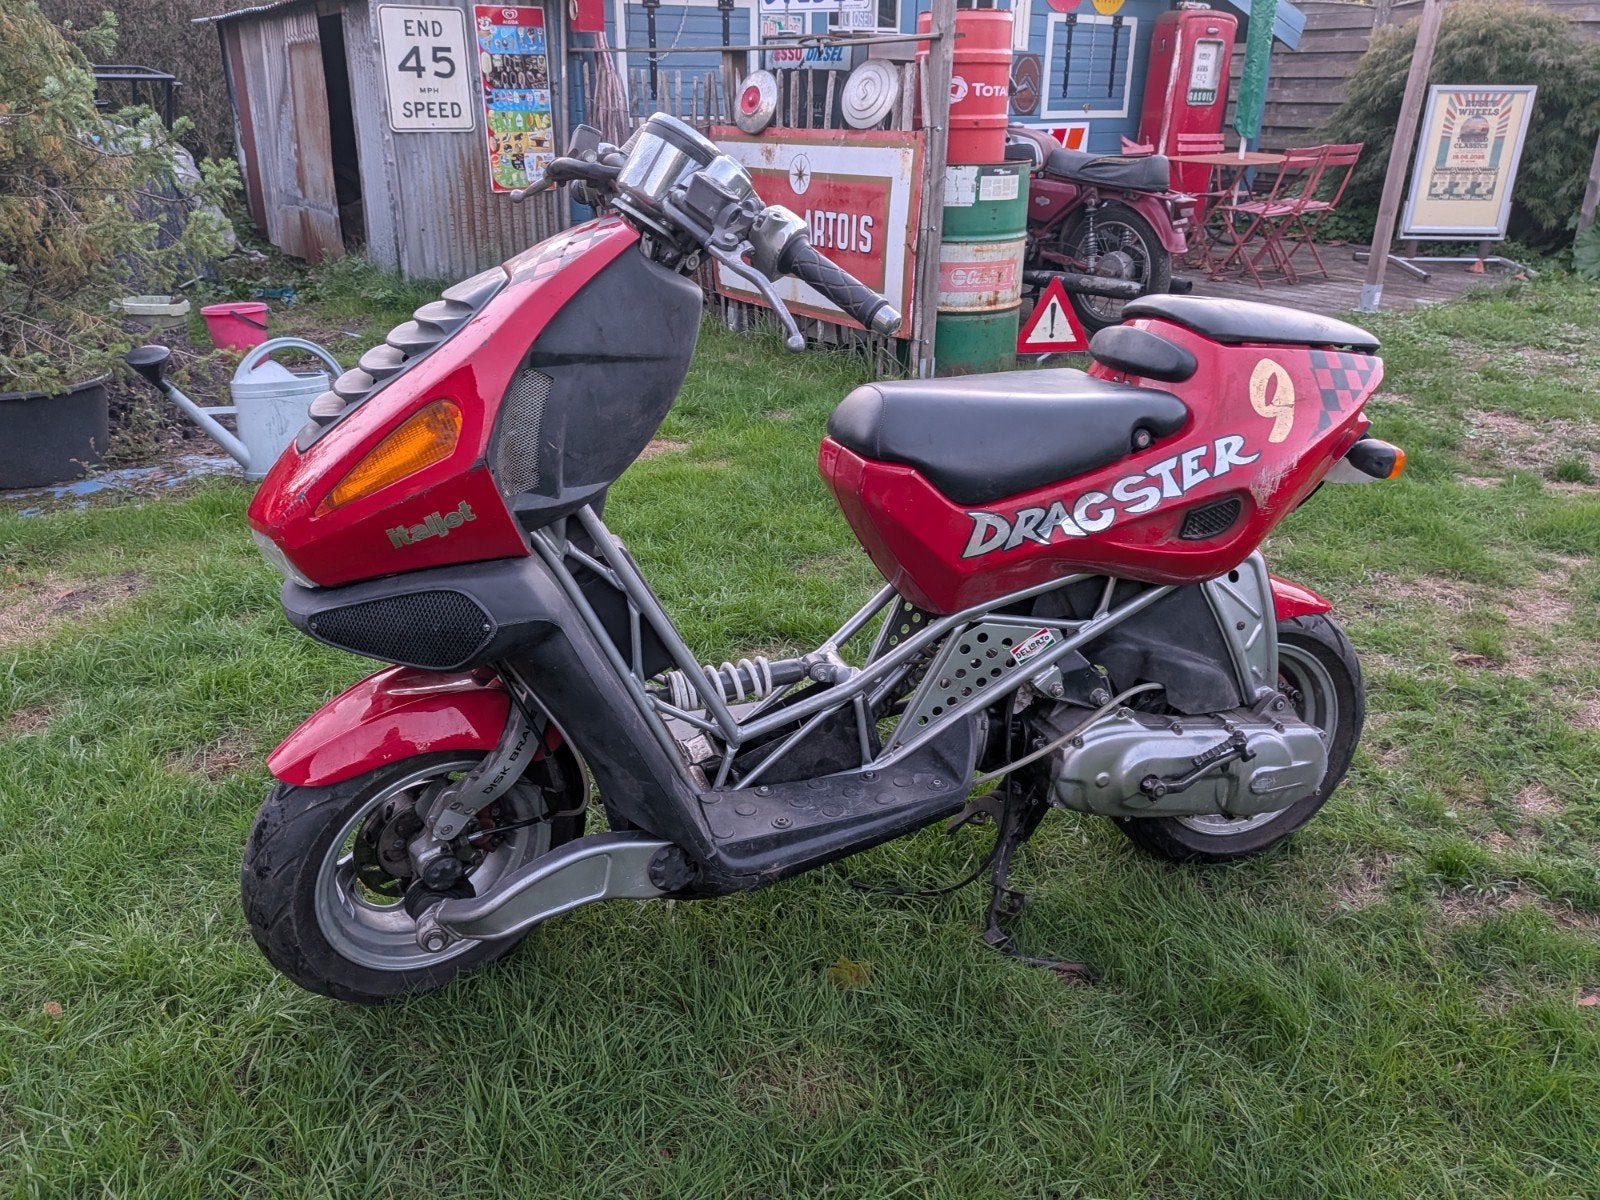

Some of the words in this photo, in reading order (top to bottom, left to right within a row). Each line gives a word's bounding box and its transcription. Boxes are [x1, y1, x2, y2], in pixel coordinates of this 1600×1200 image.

[404, 19, 443, 37] END
[843, 12, 874, 27] COSED
[398, 46, 456, 79] 45
[1189, 92, 1213, 101] GASOIL
[402, 101, 462, 119] SPEED
[1459, 108, 1500, 116] WHEELS
[804, 208, 875, 253] ARTOIS
[1249, 358, 1295, 443] 9
[961, 434, 1261, 559] DRAGSTER
[482, 765, 511, 794] DISK
